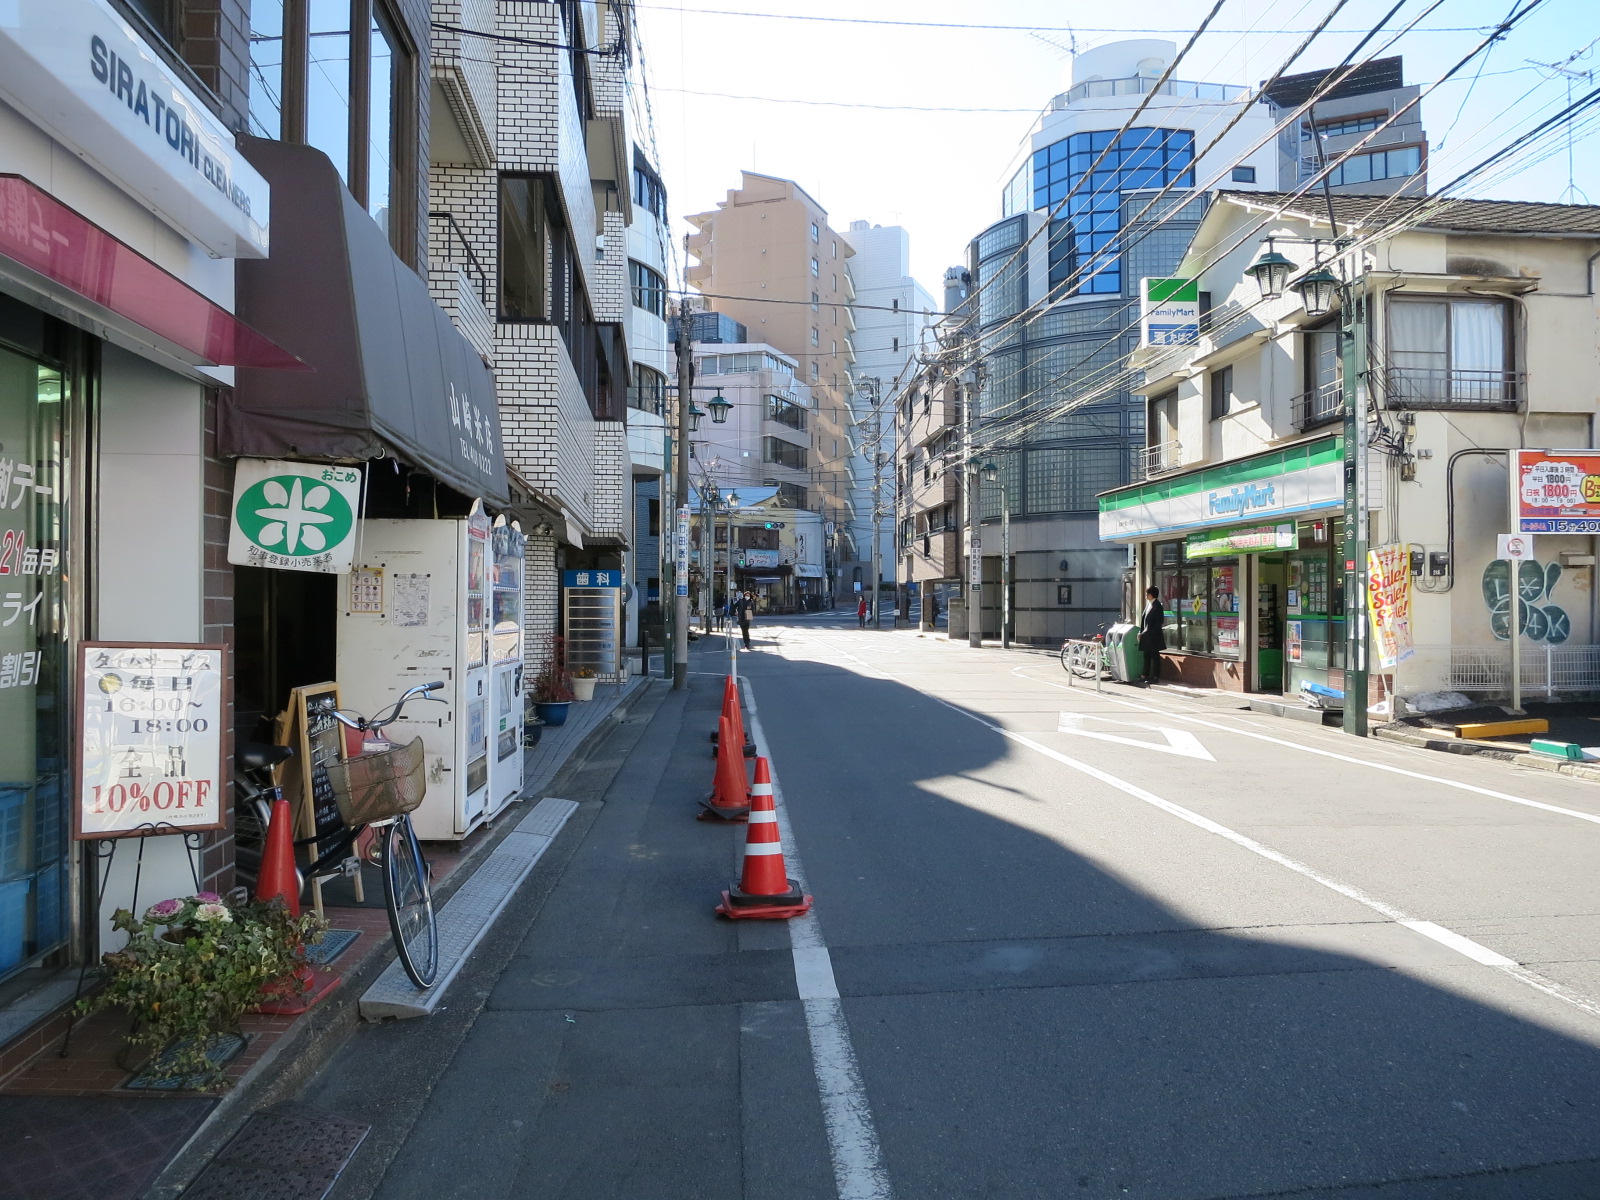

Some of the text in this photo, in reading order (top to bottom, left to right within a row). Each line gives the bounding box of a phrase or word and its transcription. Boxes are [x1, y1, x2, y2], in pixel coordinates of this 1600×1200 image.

[90, 34, 251, 218] SIRATORI CLEANERS
[321, 469, 357, 483] おこめ
[1209, 482, 1275, 516] FamilyMart
[247, 544, 333, 568] 知事登録小売業者
[576, 572, 610, 586] 歯科
[1369, 565, 1408, 592] Sale!
[1373, 583, 1408, 609] Sale!
[0, 651, 42, 688] 割引
[95, 653, 211, 670] タイムサービス
[130, 676, 193, 692] 毎日
[131, 718, 208, 734] 18:00
[119, 745, 186, 778] 全品
[92, 779, 211, 814] 10%OFF
